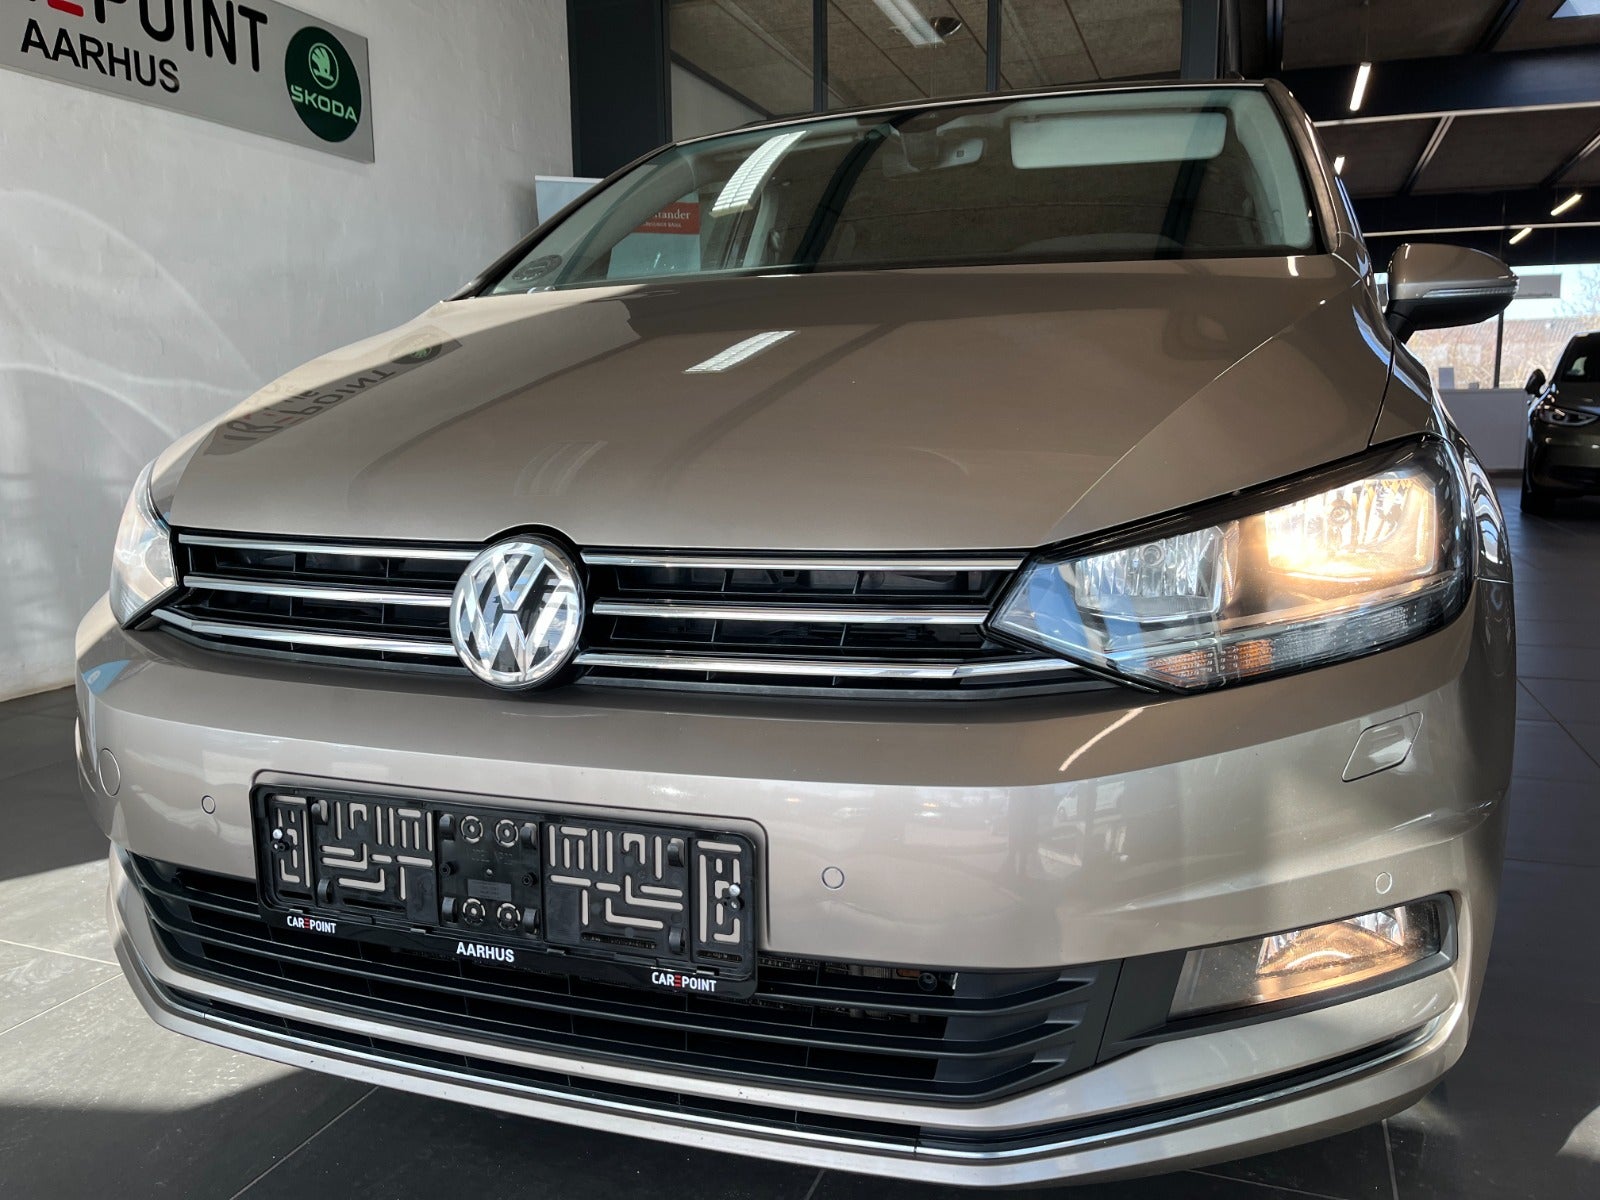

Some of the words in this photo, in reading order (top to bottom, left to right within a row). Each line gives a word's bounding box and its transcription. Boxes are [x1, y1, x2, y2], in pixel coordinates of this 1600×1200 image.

[20, 18, 180, 93] AARHUS
[655, 208, 691, 220] tander
[456, 941, 515, 963] AARHUS
